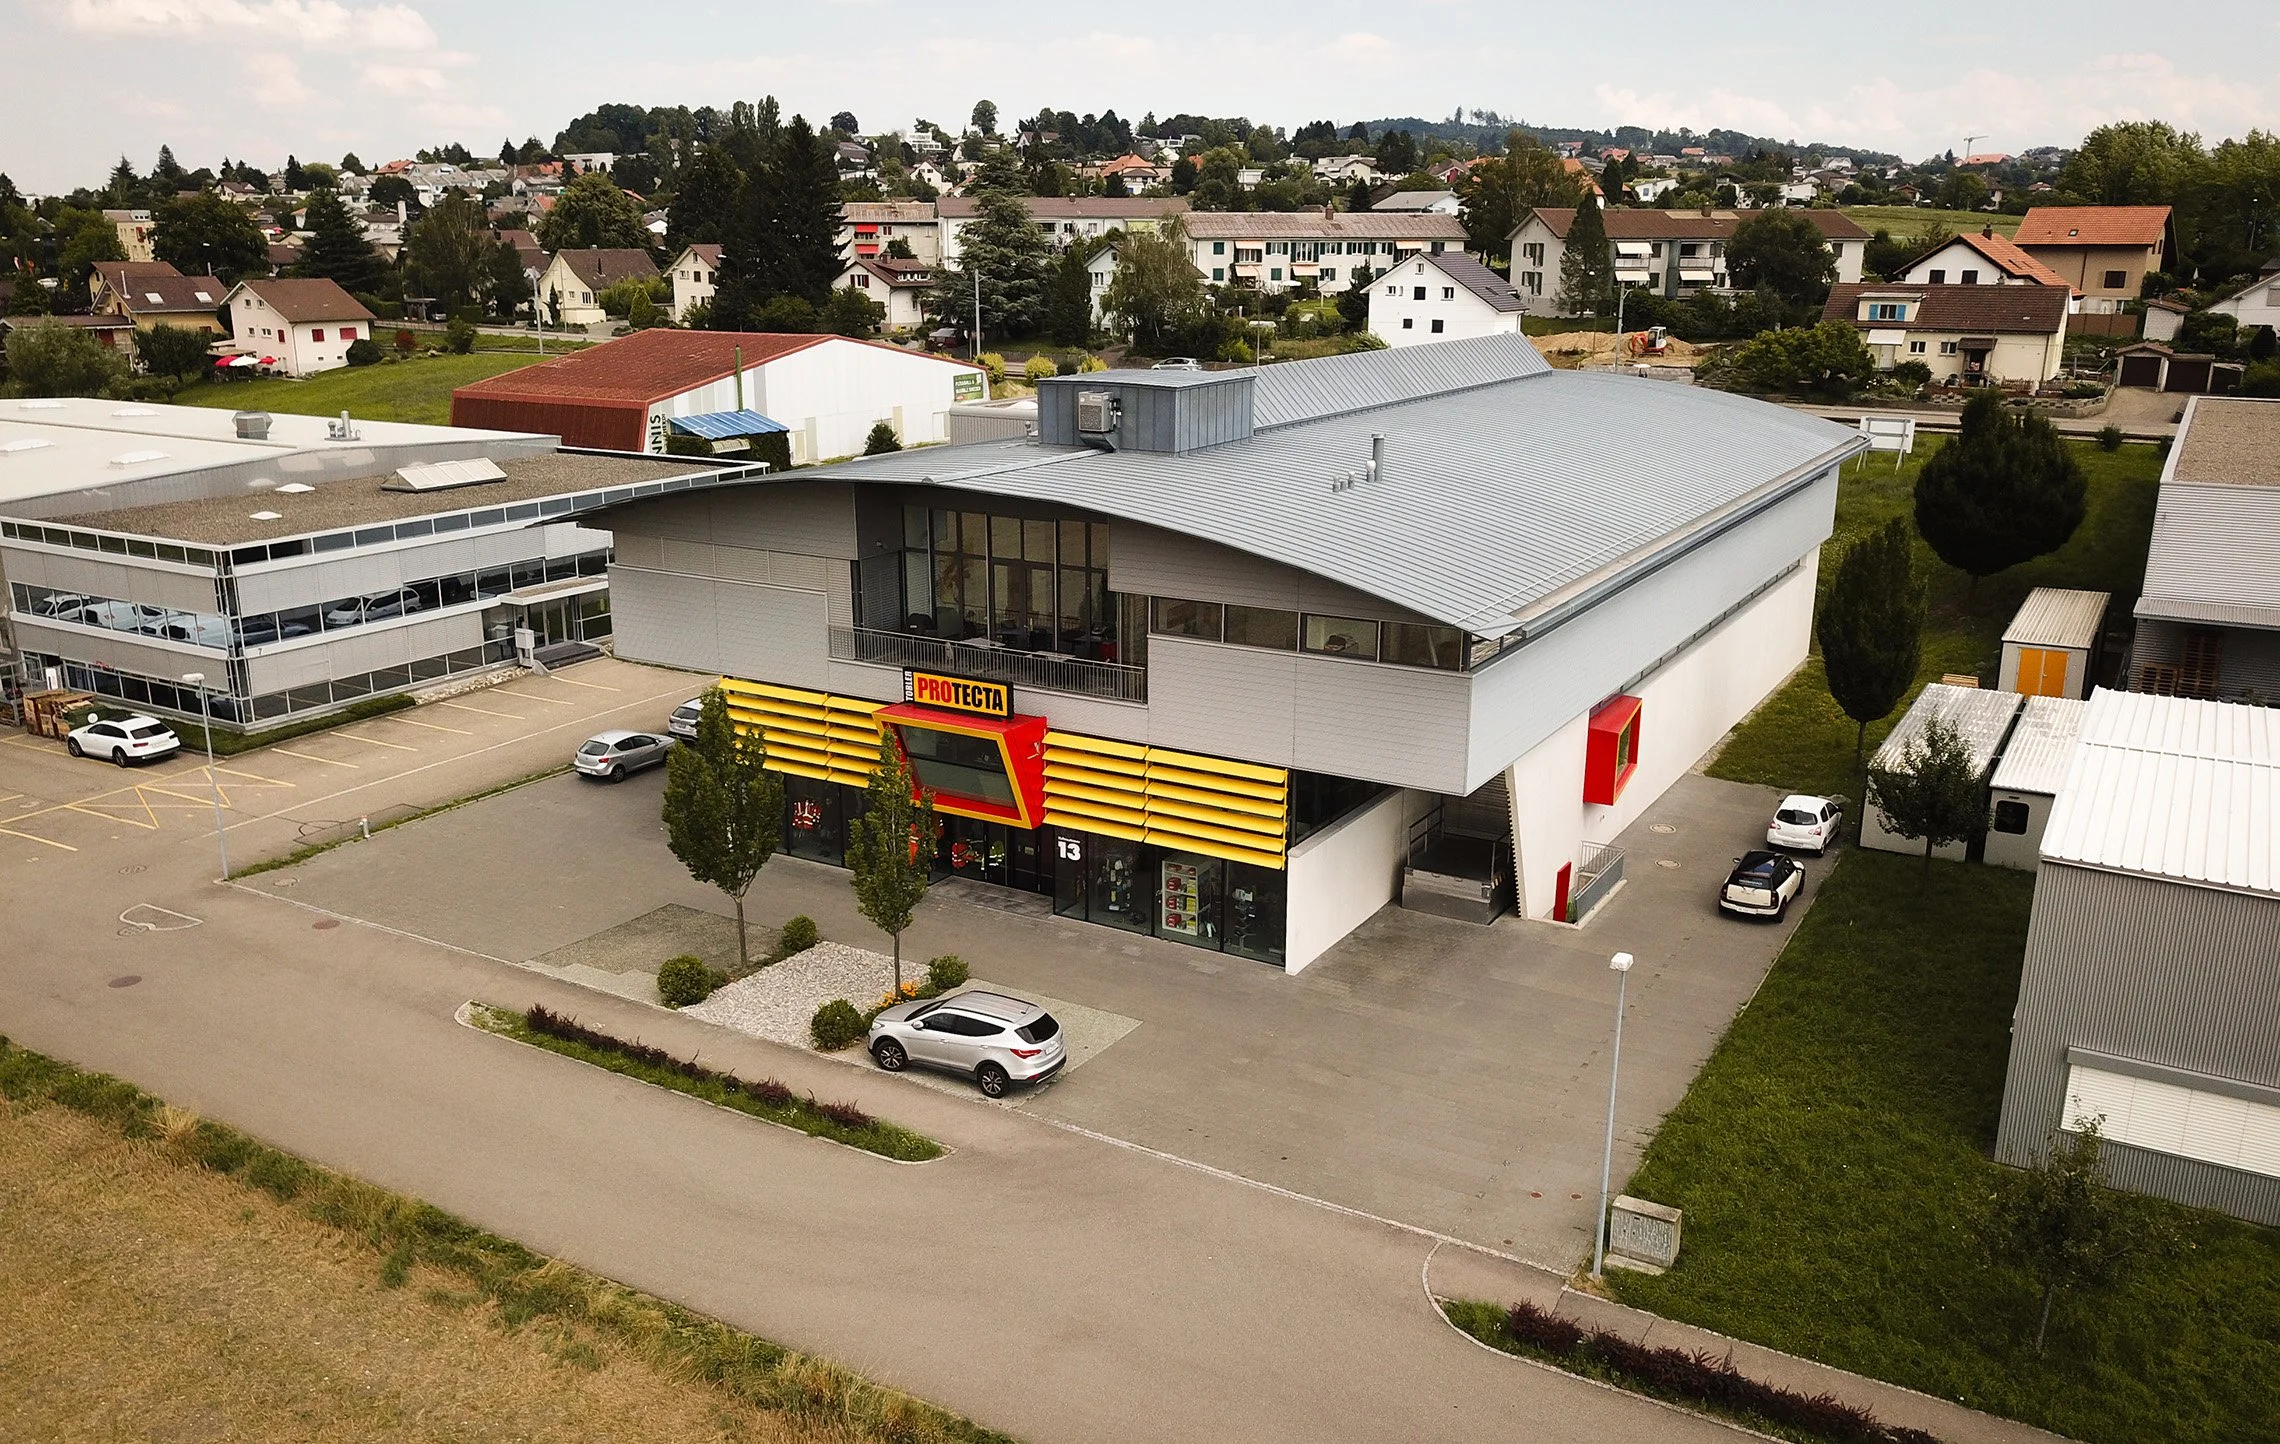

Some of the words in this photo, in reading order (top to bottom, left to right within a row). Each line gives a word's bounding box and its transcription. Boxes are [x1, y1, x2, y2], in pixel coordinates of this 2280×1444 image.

[904, 671, 914, 701] TOBLER
[917, 677, 1004, 712] PROTECTA
[1057, 841, 1081, 861] 13
